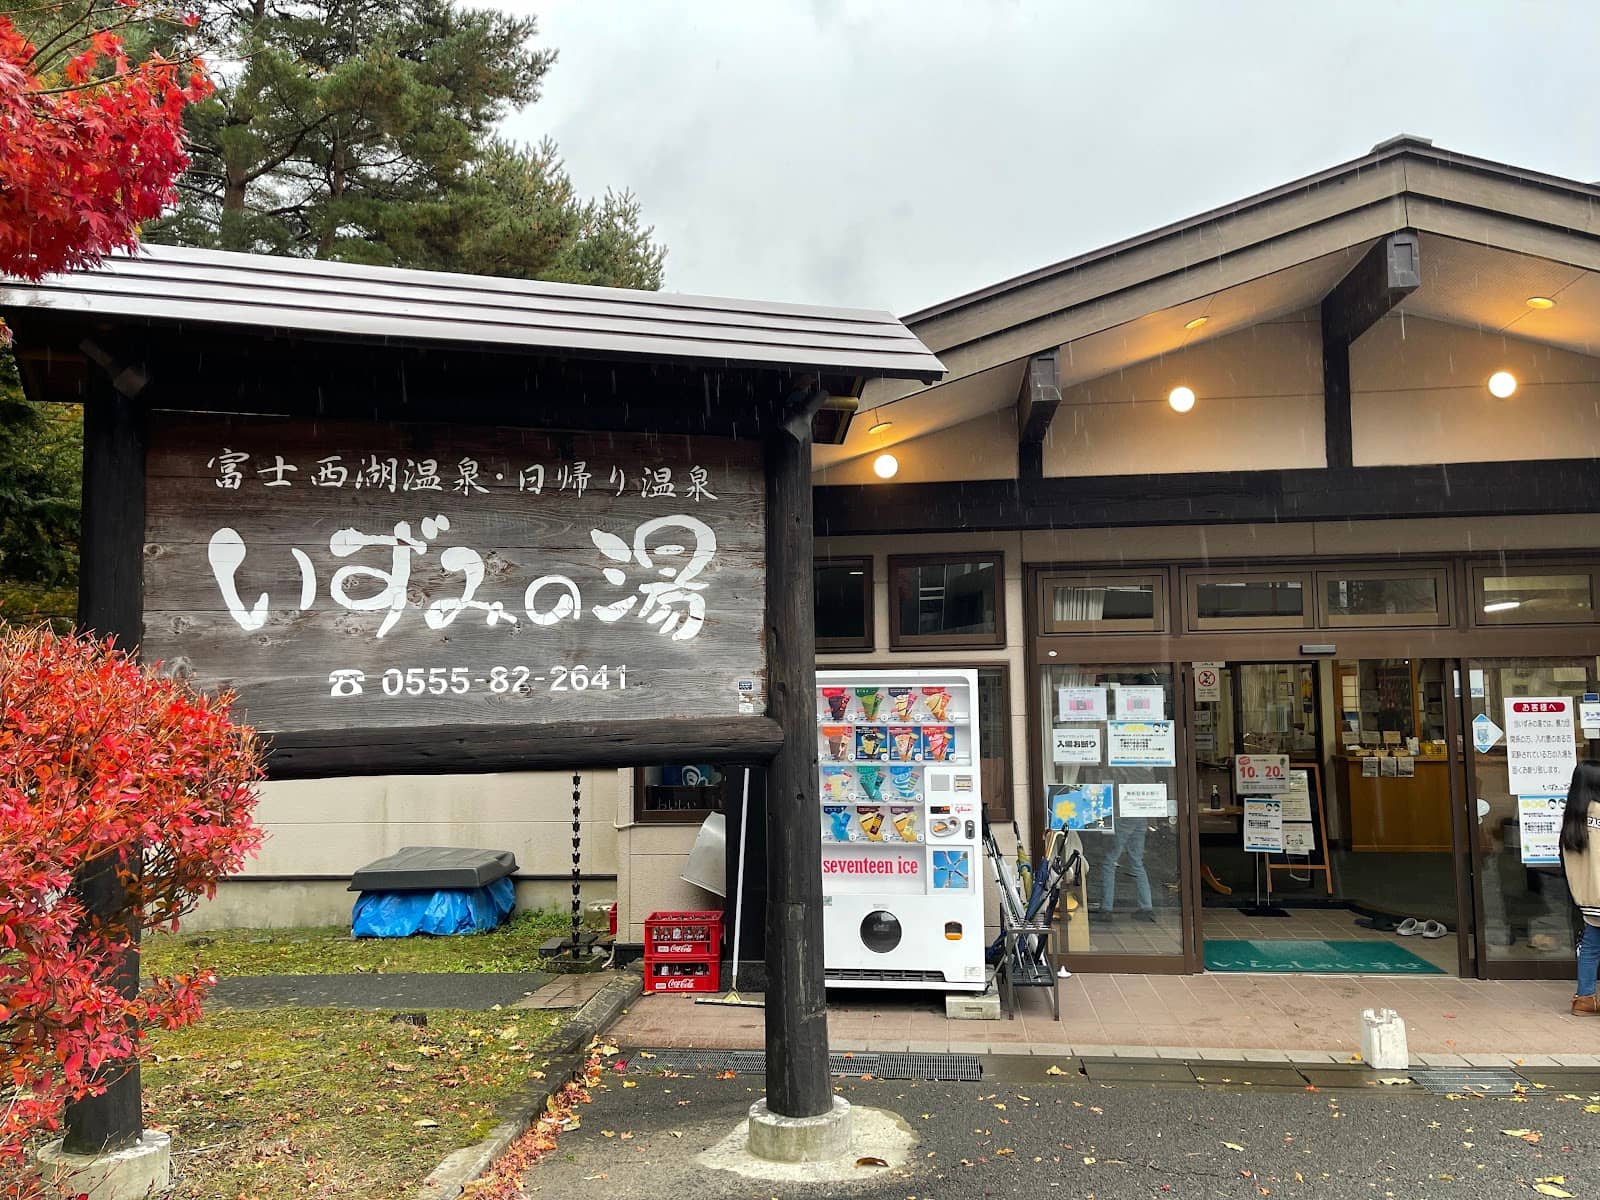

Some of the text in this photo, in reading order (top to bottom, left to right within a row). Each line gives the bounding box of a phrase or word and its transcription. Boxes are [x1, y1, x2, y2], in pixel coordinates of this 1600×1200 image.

[207, 447, 719, 502] 富士西湖温泉・日帰り温泉
[208, 515, 718, 640] いずみの湯
[381, 664, 629, 697] 0555-82-2641
[823, 855, 919, 875] seventeen ice
